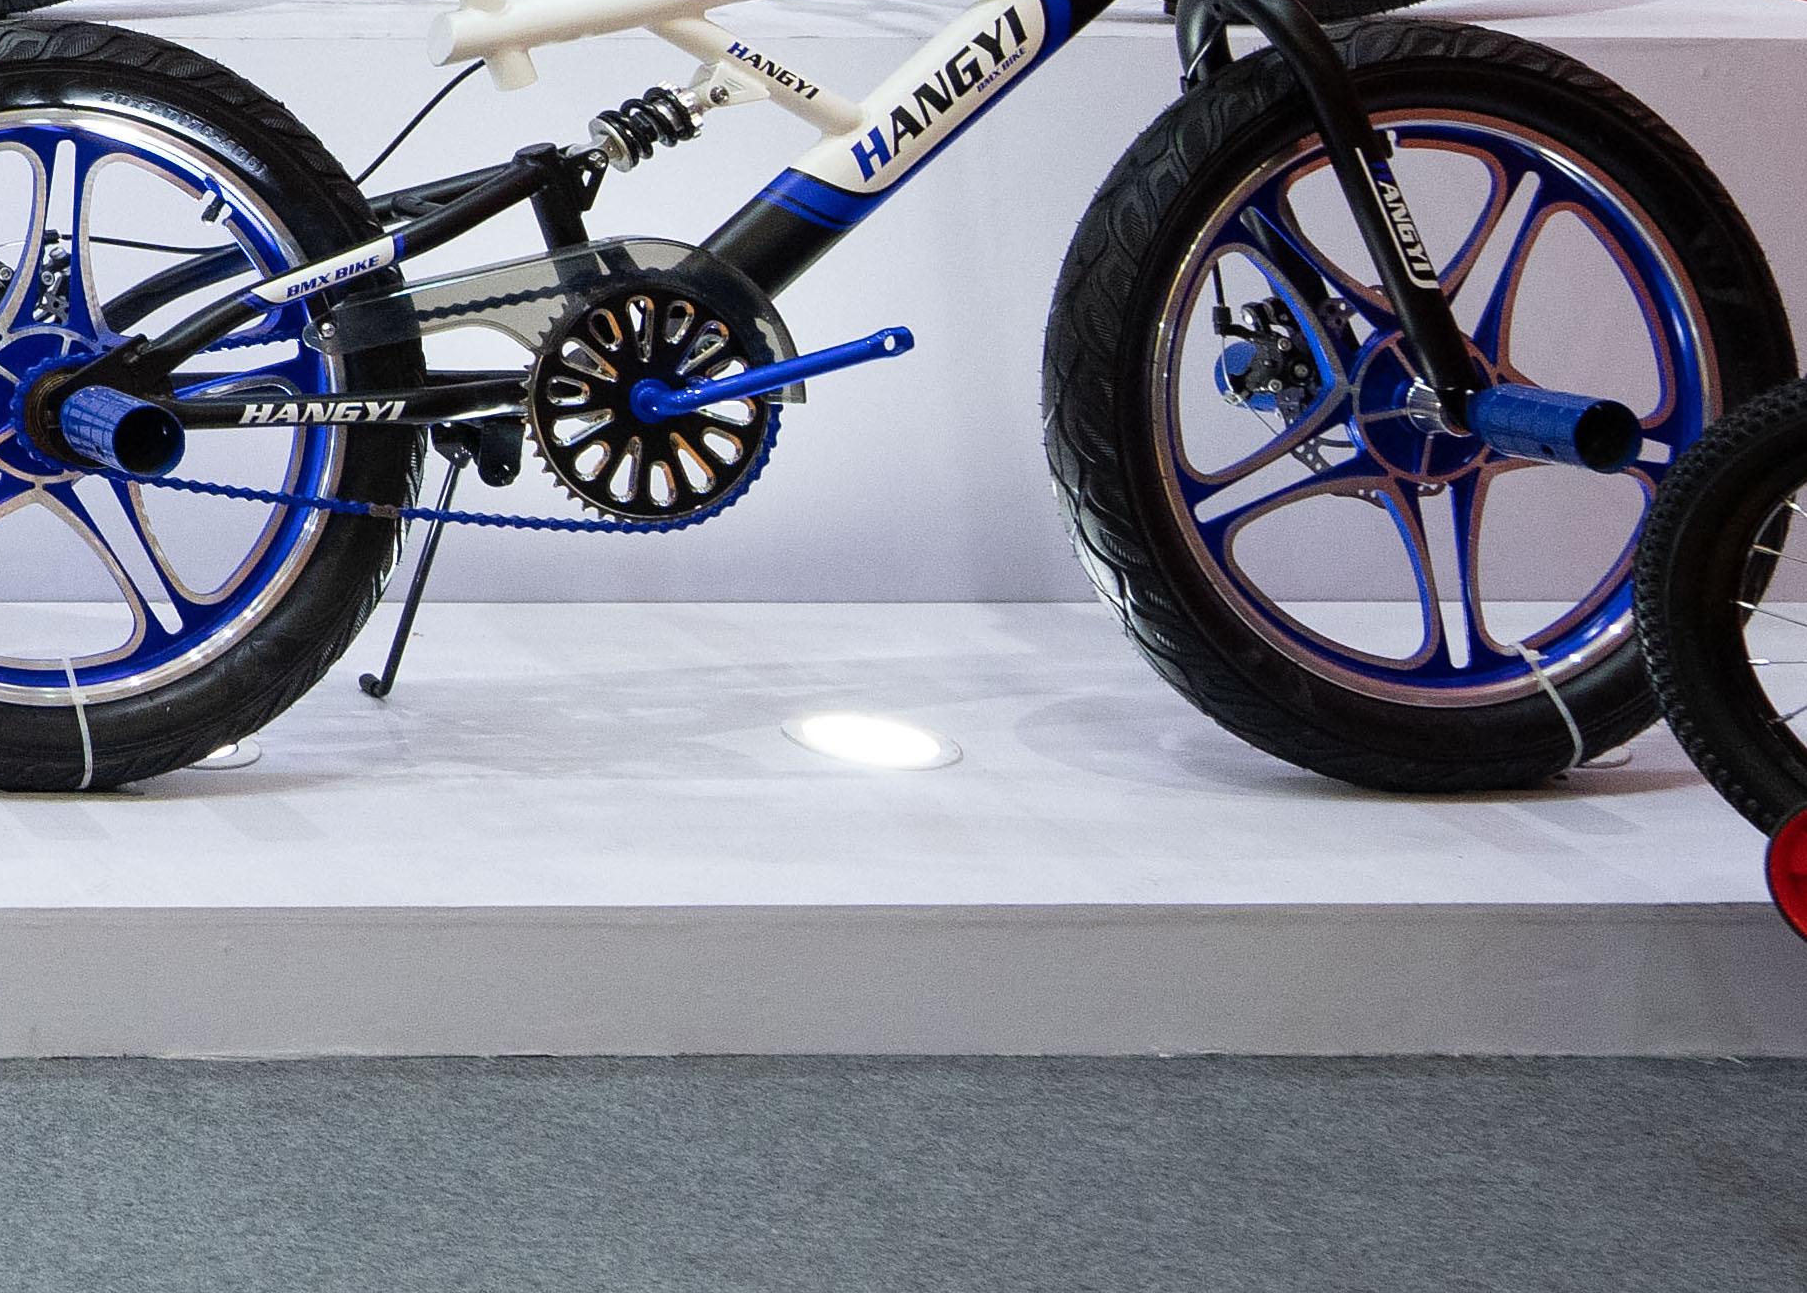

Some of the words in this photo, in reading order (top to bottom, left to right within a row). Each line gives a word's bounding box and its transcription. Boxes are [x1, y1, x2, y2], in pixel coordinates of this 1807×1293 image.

[725, 40, 821, 102] HANGYI
[850, 4, 1029, 185] HANGYI
[285, 271, 331, 301] BMX
[333, 254, 382, 285] BIKE
[238, 398, 407, 426] HANGYI
